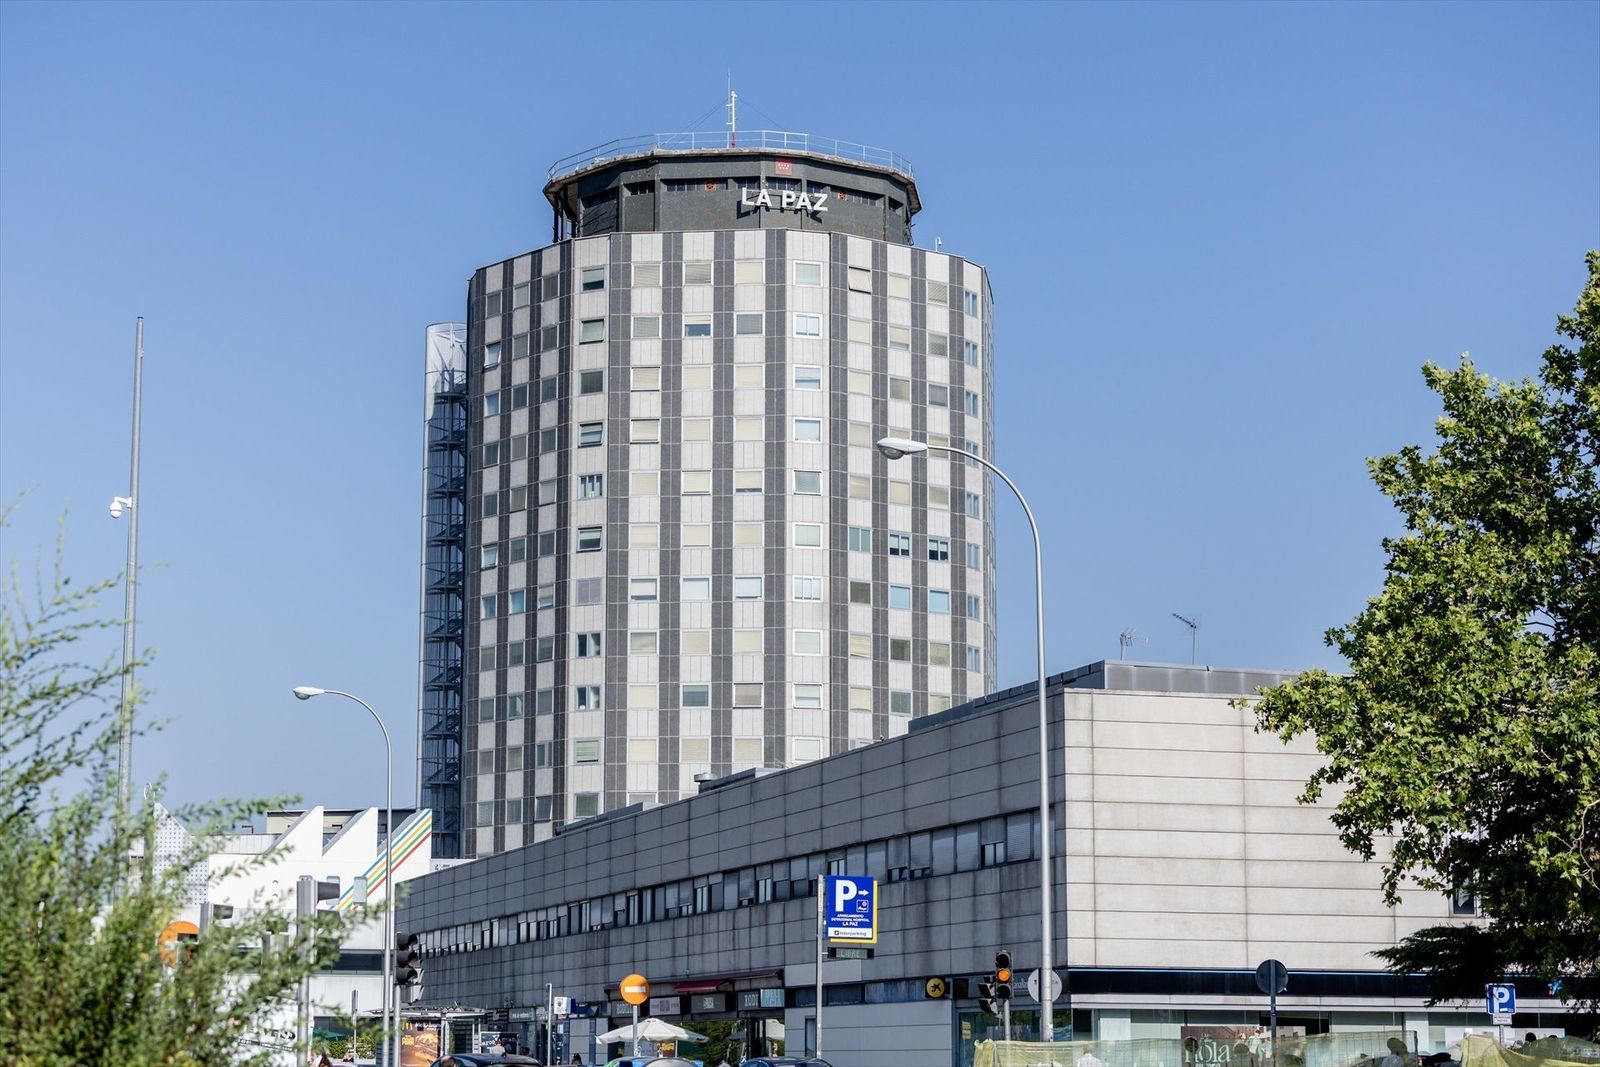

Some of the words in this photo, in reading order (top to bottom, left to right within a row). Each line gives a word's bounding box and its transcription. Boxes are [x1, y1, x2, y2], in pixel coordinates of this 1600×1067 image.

[742, 187, 772, 206] LA
[782, 190, 828, 211] PAZ
[835, 879, 858, 912] P
[1493, 987, 1510, 1013] P
